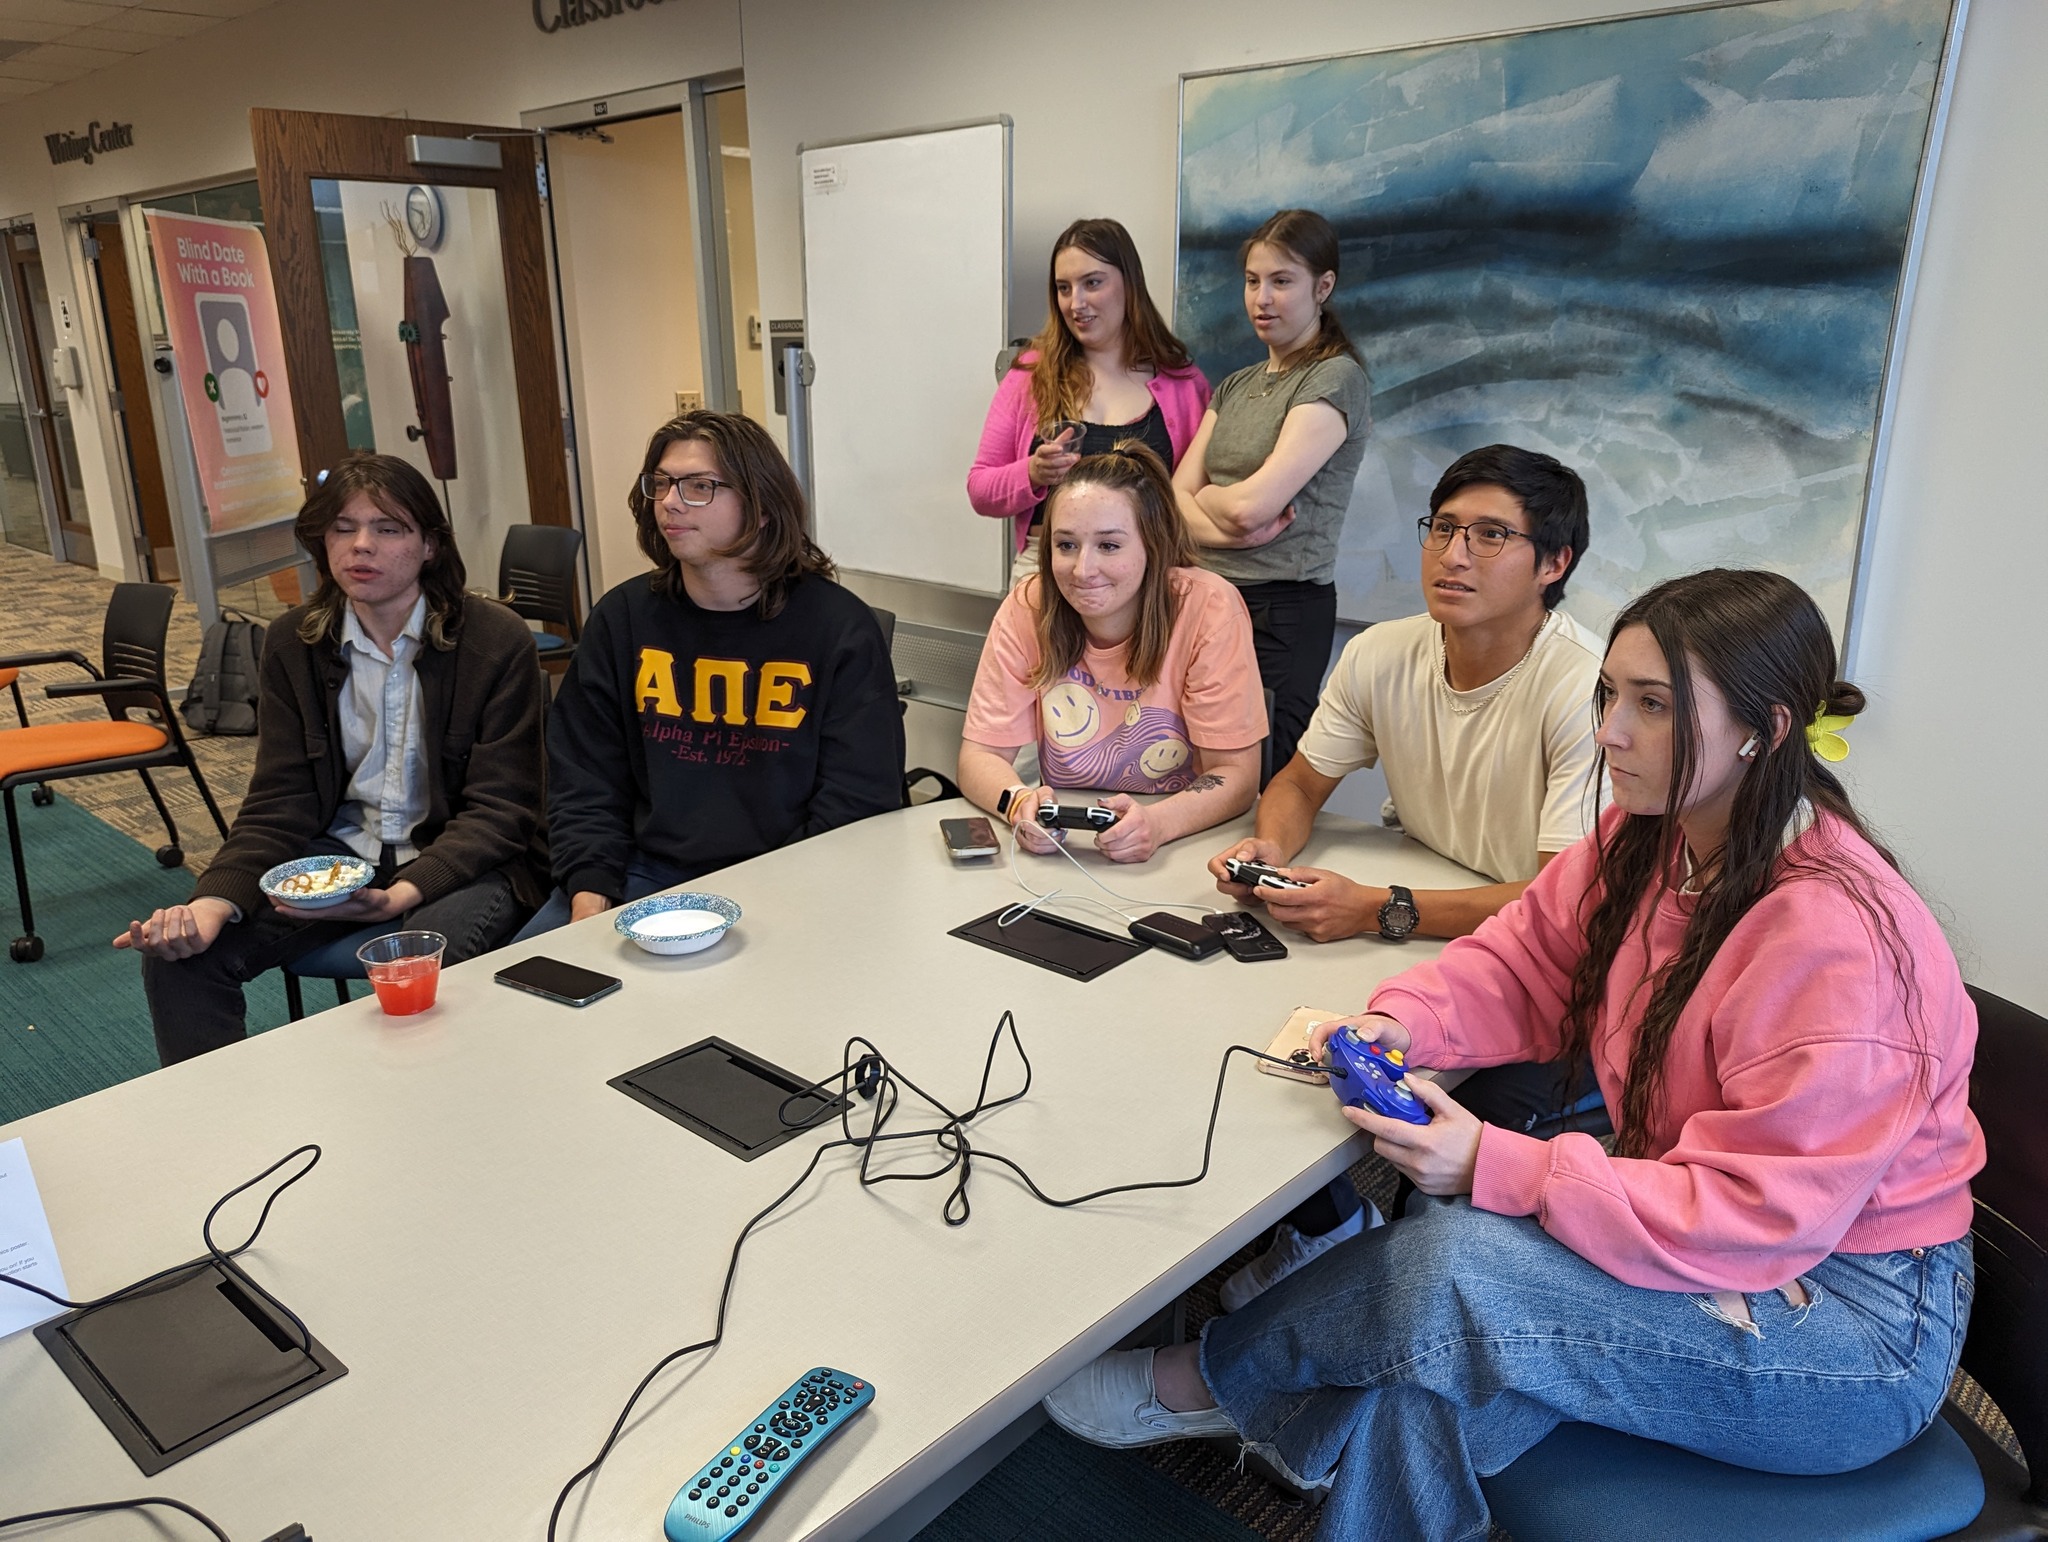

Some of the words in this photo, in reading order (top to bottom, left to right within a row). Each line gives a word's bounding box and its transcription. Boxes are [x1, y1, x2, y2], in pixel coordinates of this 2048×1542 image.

[44, 130, 93, 165] Writing
[88, 121, 134, 154] Center
[176, 237, 211, 261] Blind
[211, 241, 246, 264] Date
[176, 262, 210, 285] With
[211, 269, 220, 286] a
[220, 266, 255, 288] Book
[702, 730, 723, 746] Pi
[785, 1419, 798, 1427] OK
[684, 1513, 711, 1529] PHILIPS
